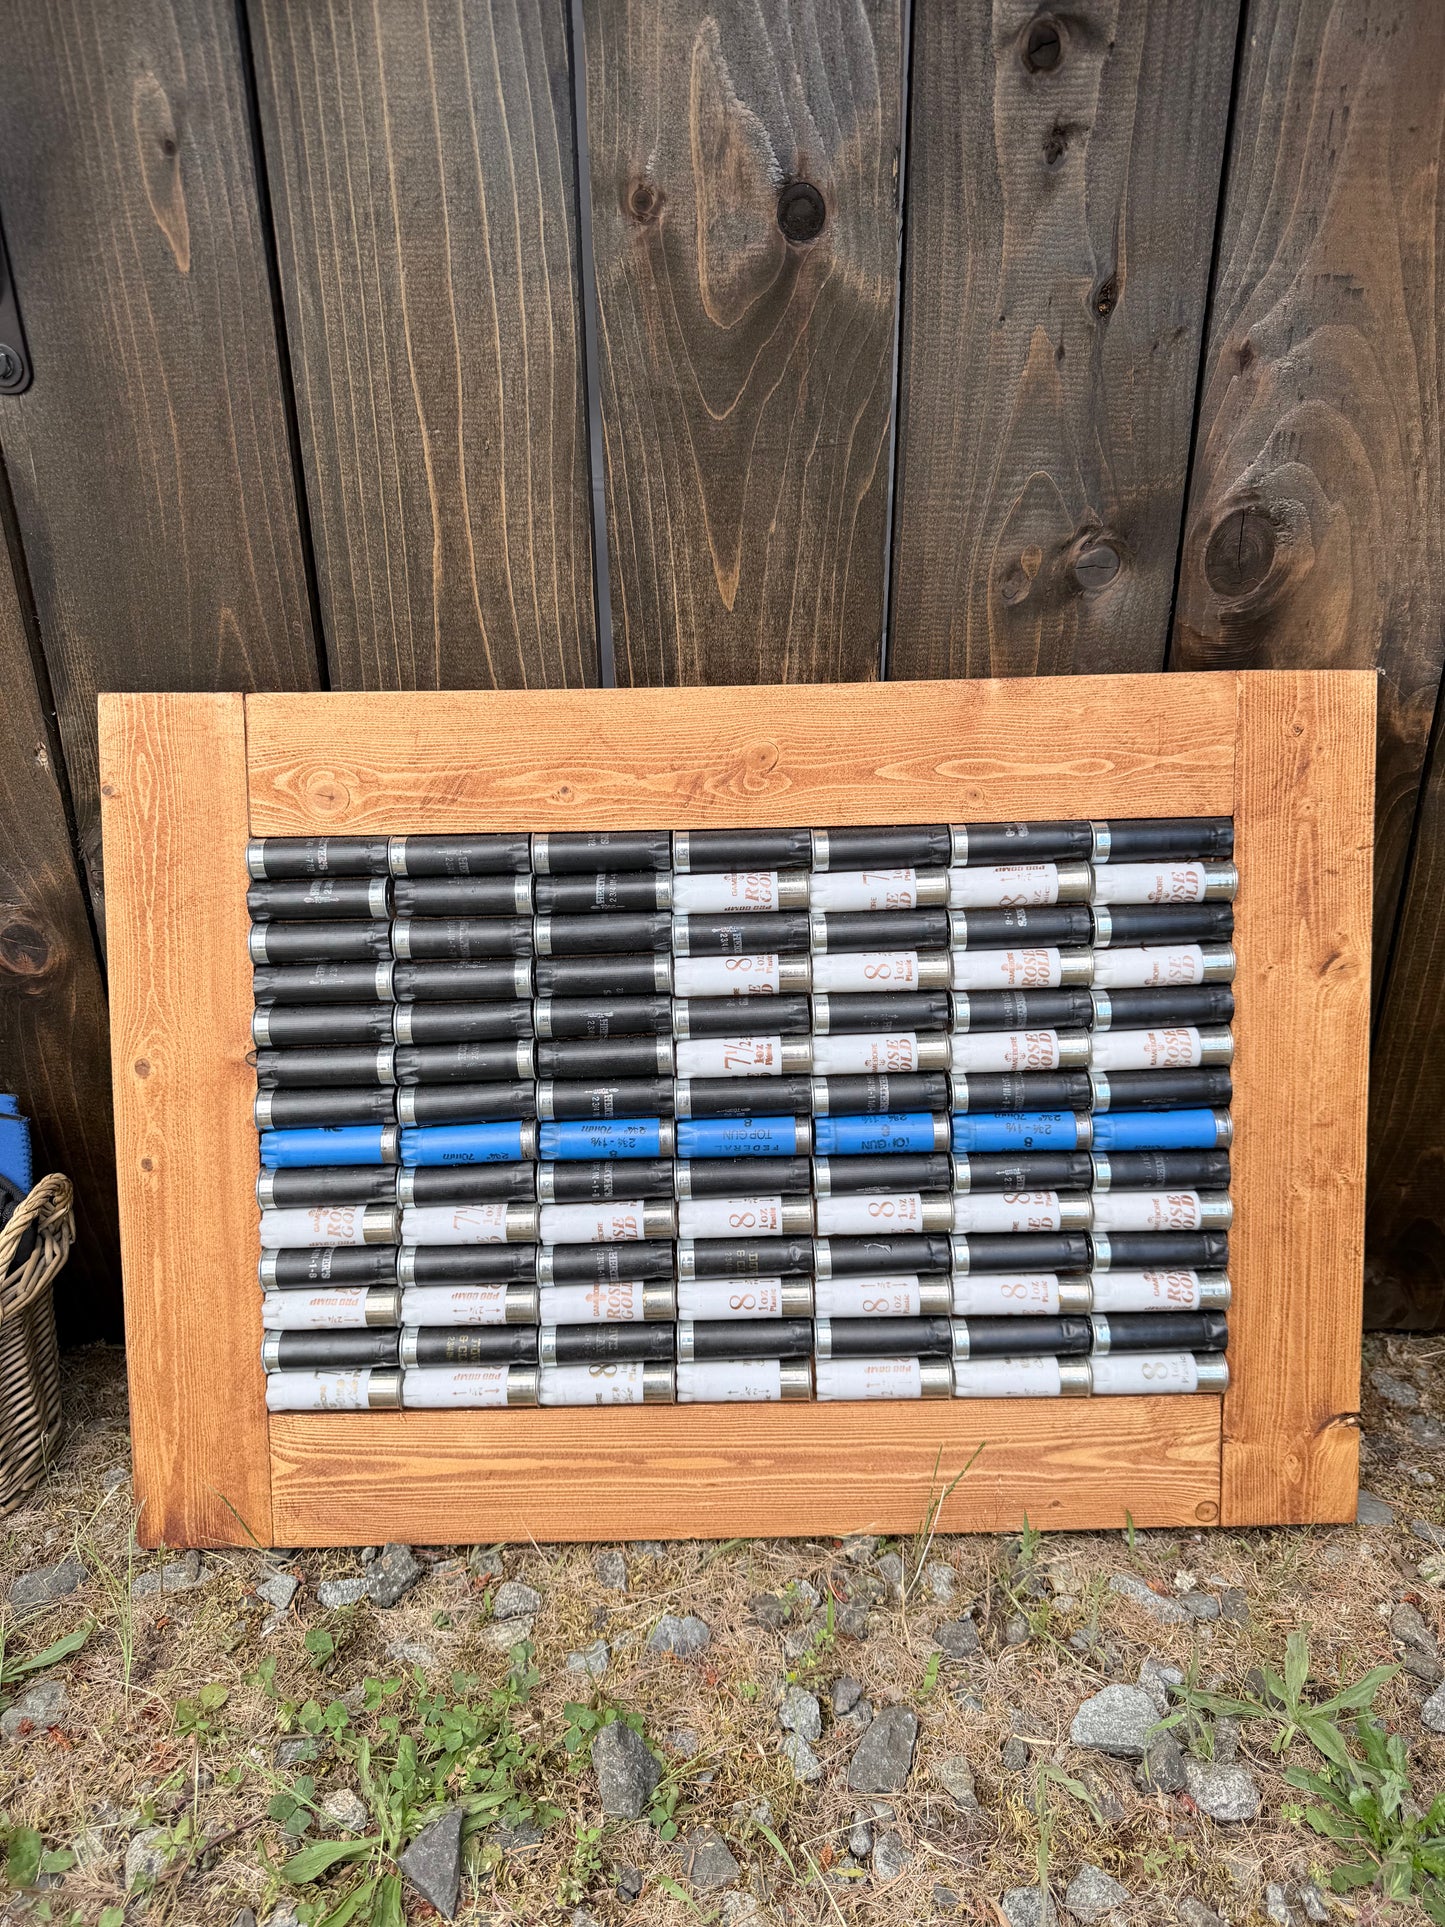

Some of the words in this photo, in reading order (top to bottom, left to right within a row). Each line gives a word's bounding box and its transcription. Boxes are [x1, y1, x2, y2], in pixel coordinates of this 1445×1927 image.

[726, 958, 752, 971] 8
[864, 964, 891, 979] 8
[1039, 1032, 1053, 1070] OLD
[722, 1129, 747, 1140] GUN
[749, 1129, 773, 1140] TOP
[715, 1144, 779, 1152] FEDERAL
[868, 1201, 895, 1217] 8
[729, 1212, 755, 1228] 8
[1001, 1284, 1027, 1300] 8
[729, 1294, 756, 1310] 8
[863, 1298, 889, 1312] 8
[589, 1364, 617, 1378] 8
[1142, 1363, 1168, 1380] 8
